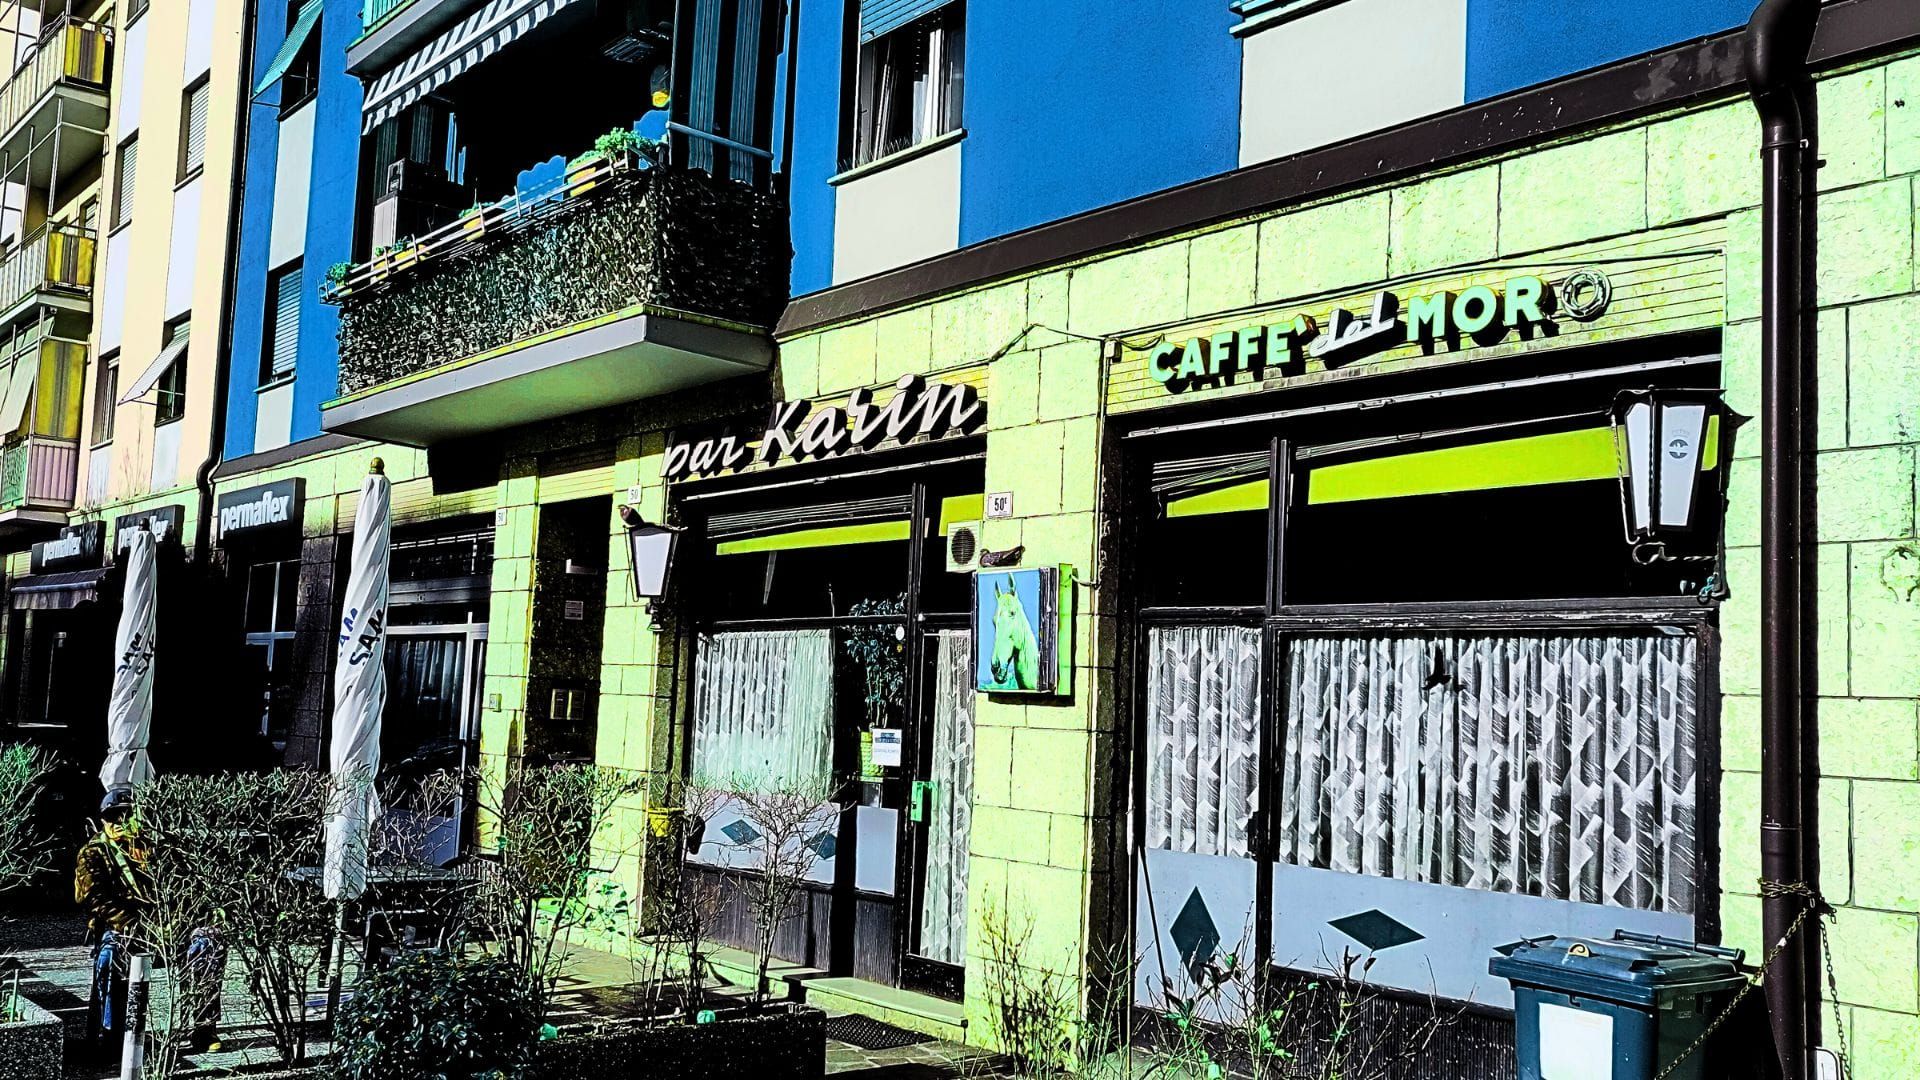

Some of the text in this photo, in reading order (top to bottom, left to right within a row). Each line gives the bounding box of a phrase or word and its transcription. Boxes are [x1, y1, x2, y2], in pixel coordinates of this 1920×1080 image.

[1309, 291, 1396, 358] del
[759, 374, 980, 461] Karin
[219, 490, 290, 540] permaflex
